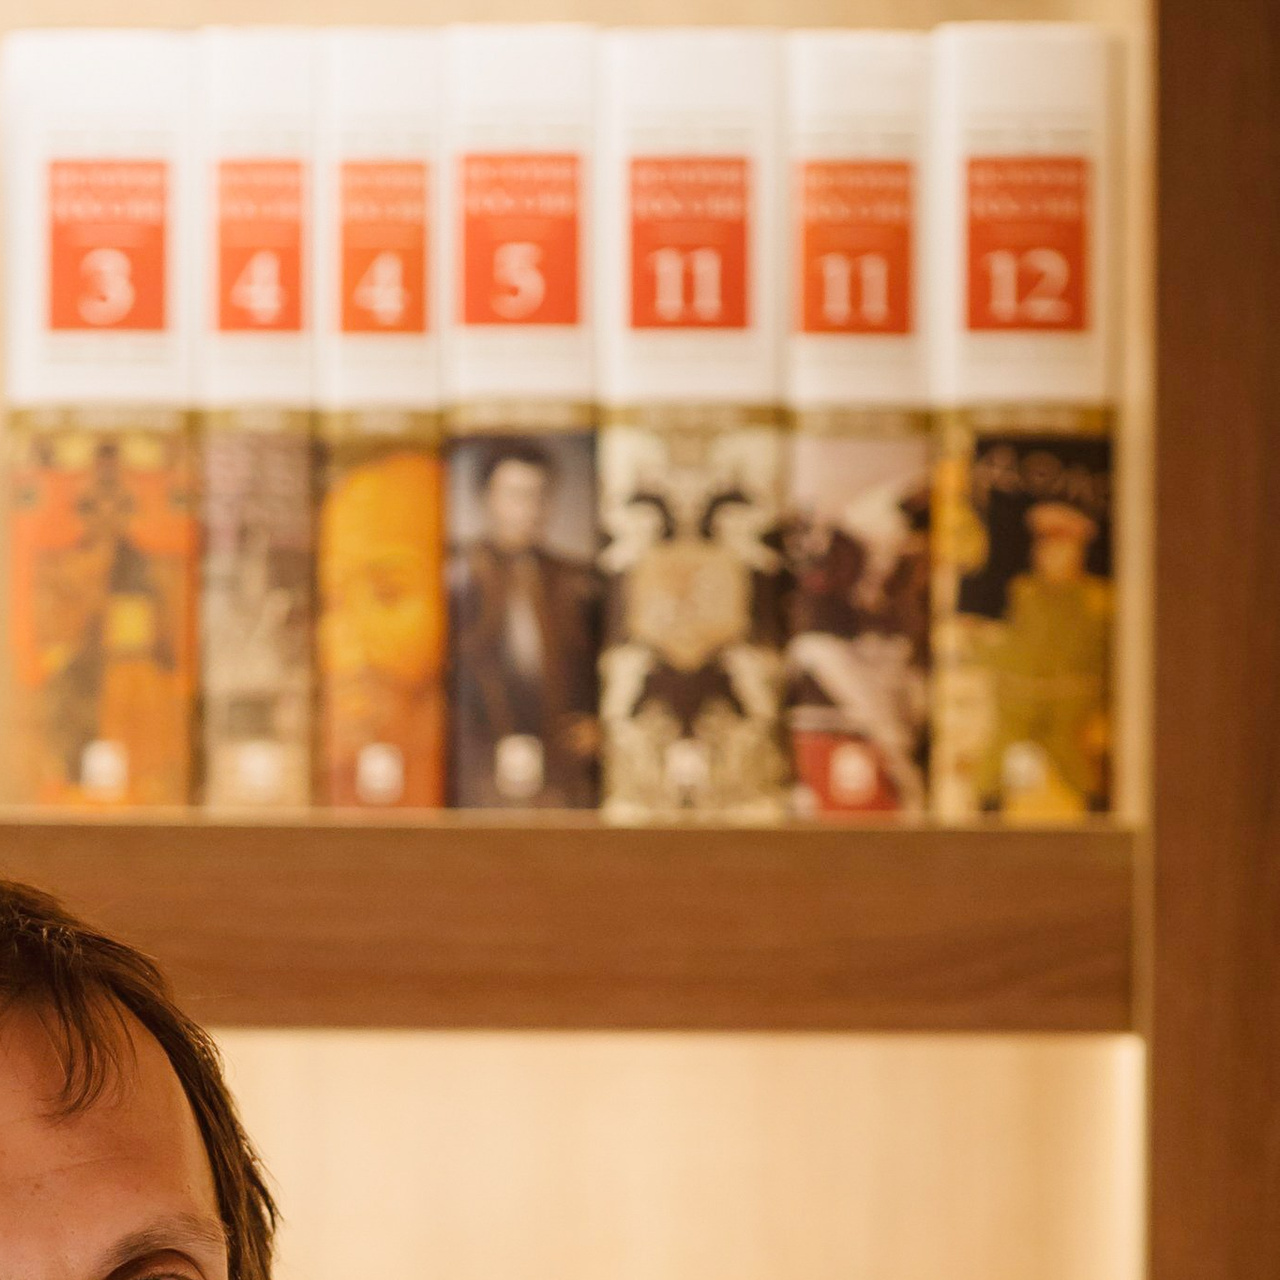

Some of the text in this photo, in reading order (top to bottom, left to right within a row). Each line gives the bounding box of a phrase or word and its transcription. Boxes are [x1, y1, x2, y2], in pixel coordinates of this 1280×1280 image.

[78, 247, 136, 325] 3
[231, 249, 287, 325] 4
[353, 249, 407, 325] 4
[489, 241, 546, 319] 5
[650, 246, 721, 321] 11
[819, 252, 889, 325] 11
[984, 248, 1073, 322] 12
